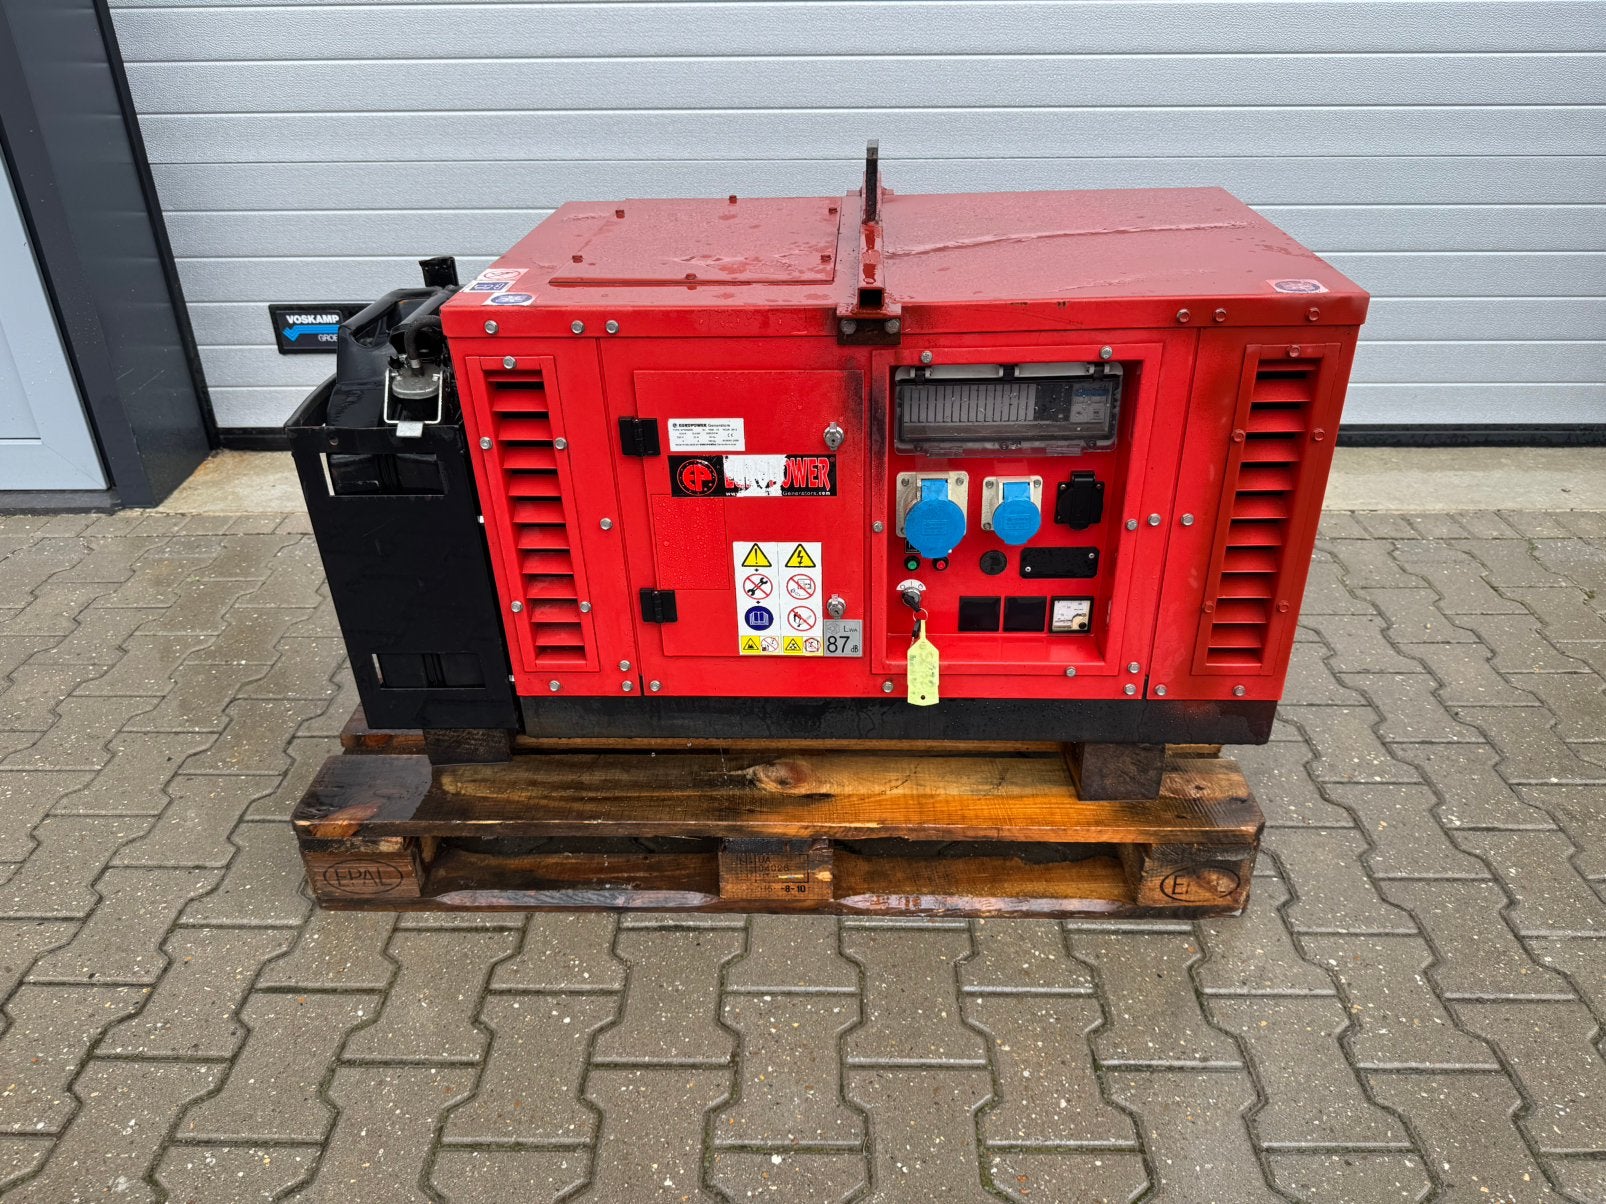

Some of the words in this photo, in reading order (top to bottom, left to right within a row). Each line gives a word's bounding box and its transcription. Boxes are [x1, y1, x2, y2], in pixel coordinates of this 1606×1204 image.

[286, 314, 340, 324] VOSKAMP
[318, 334, 338, 342] GROE
[827, 635, 850, 653] 87
[850, 644, 859, 653] dB
[335, 866, 393, 887] EPAL
